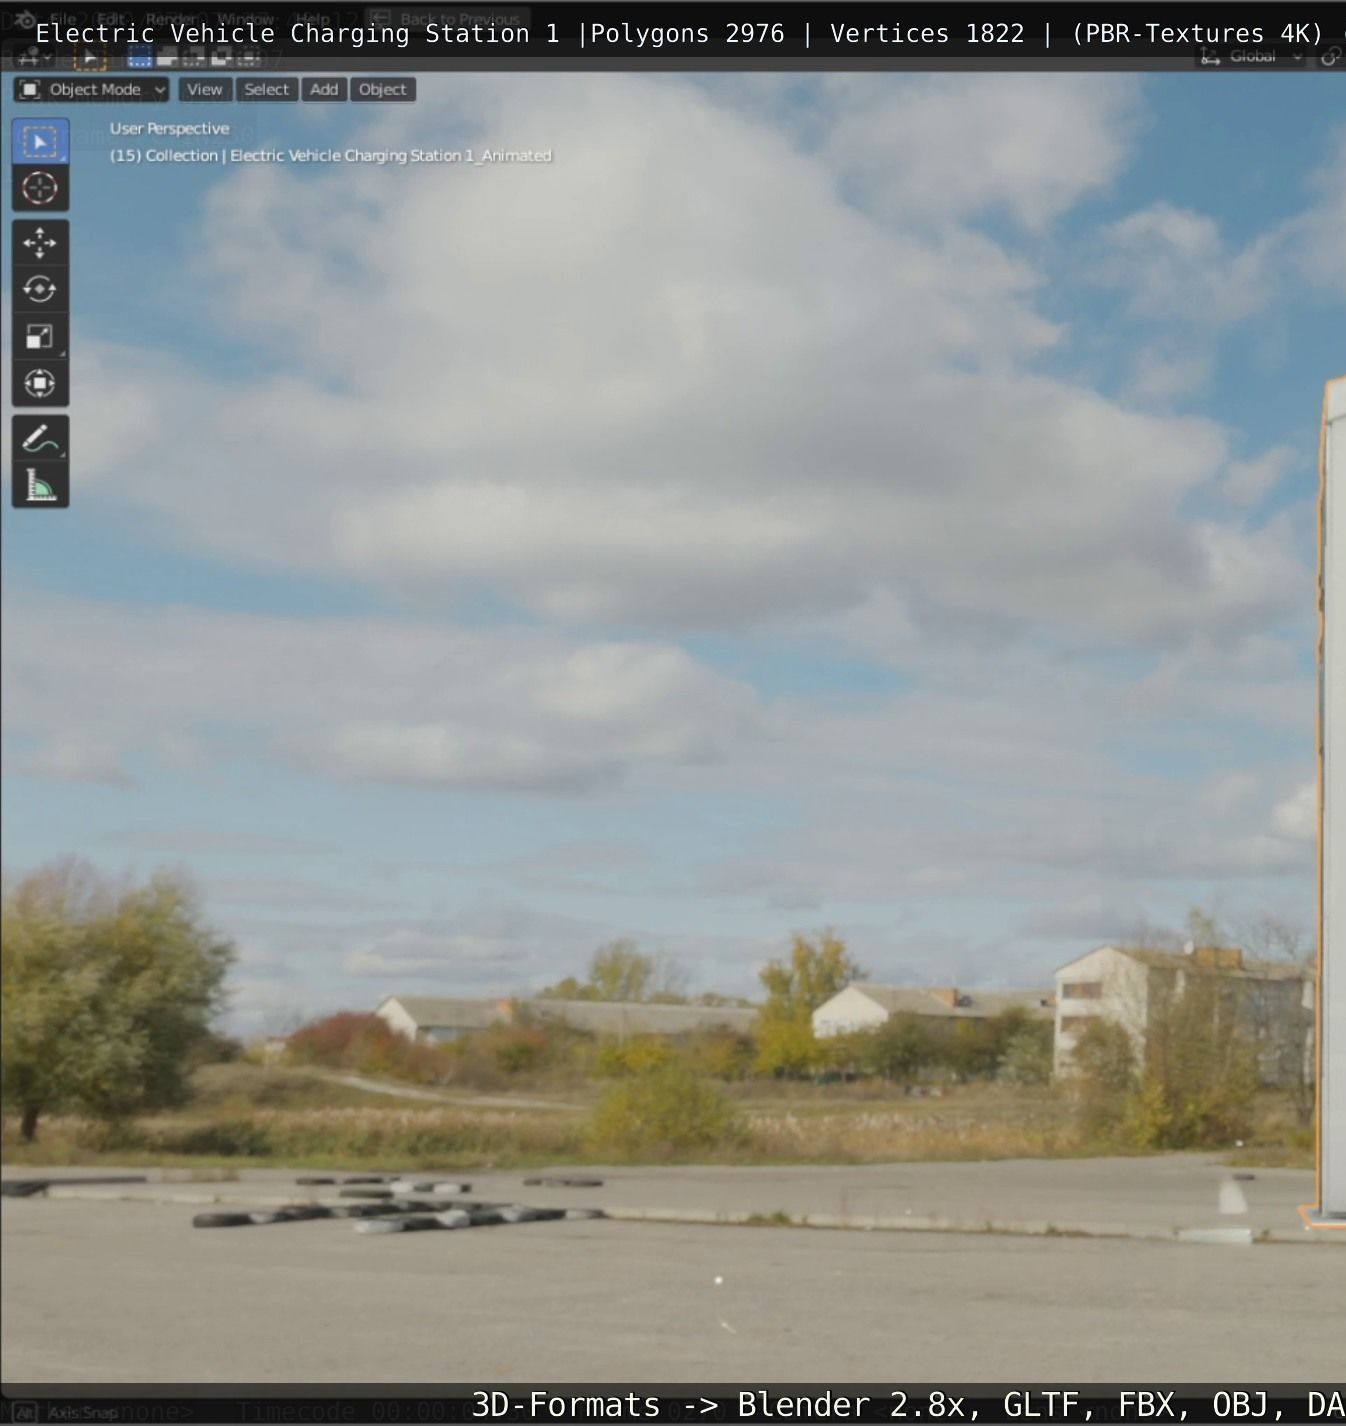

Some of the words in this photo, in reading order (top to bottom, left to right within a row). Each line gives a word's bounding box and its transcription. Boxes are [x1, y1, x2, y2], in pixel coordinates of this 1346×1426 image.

[1229, 49, 1276, 62] Global
[50, 83, 97, 98] Object
[102, 83, 141, 97] Mode
[187, 83, 224, 96] View
[244, 83, 290, 96] Select
[309, 83, 339, 96] Add
[359, 82, 408, 98] Object
[110, 122, 143, 135] User
[147, 122, 231, 138] Perspective
[110, 149, 142, 164] (15)
[146, 149, 219, 163] Collection
[231, 149, 284, 163] Electric
[288, 149, 342, 163] Vehicle
[345, 149, 407, 166] Charging
[411, 149, 463, 163] Station
[465, 149, 553, 166] 1_Animated
